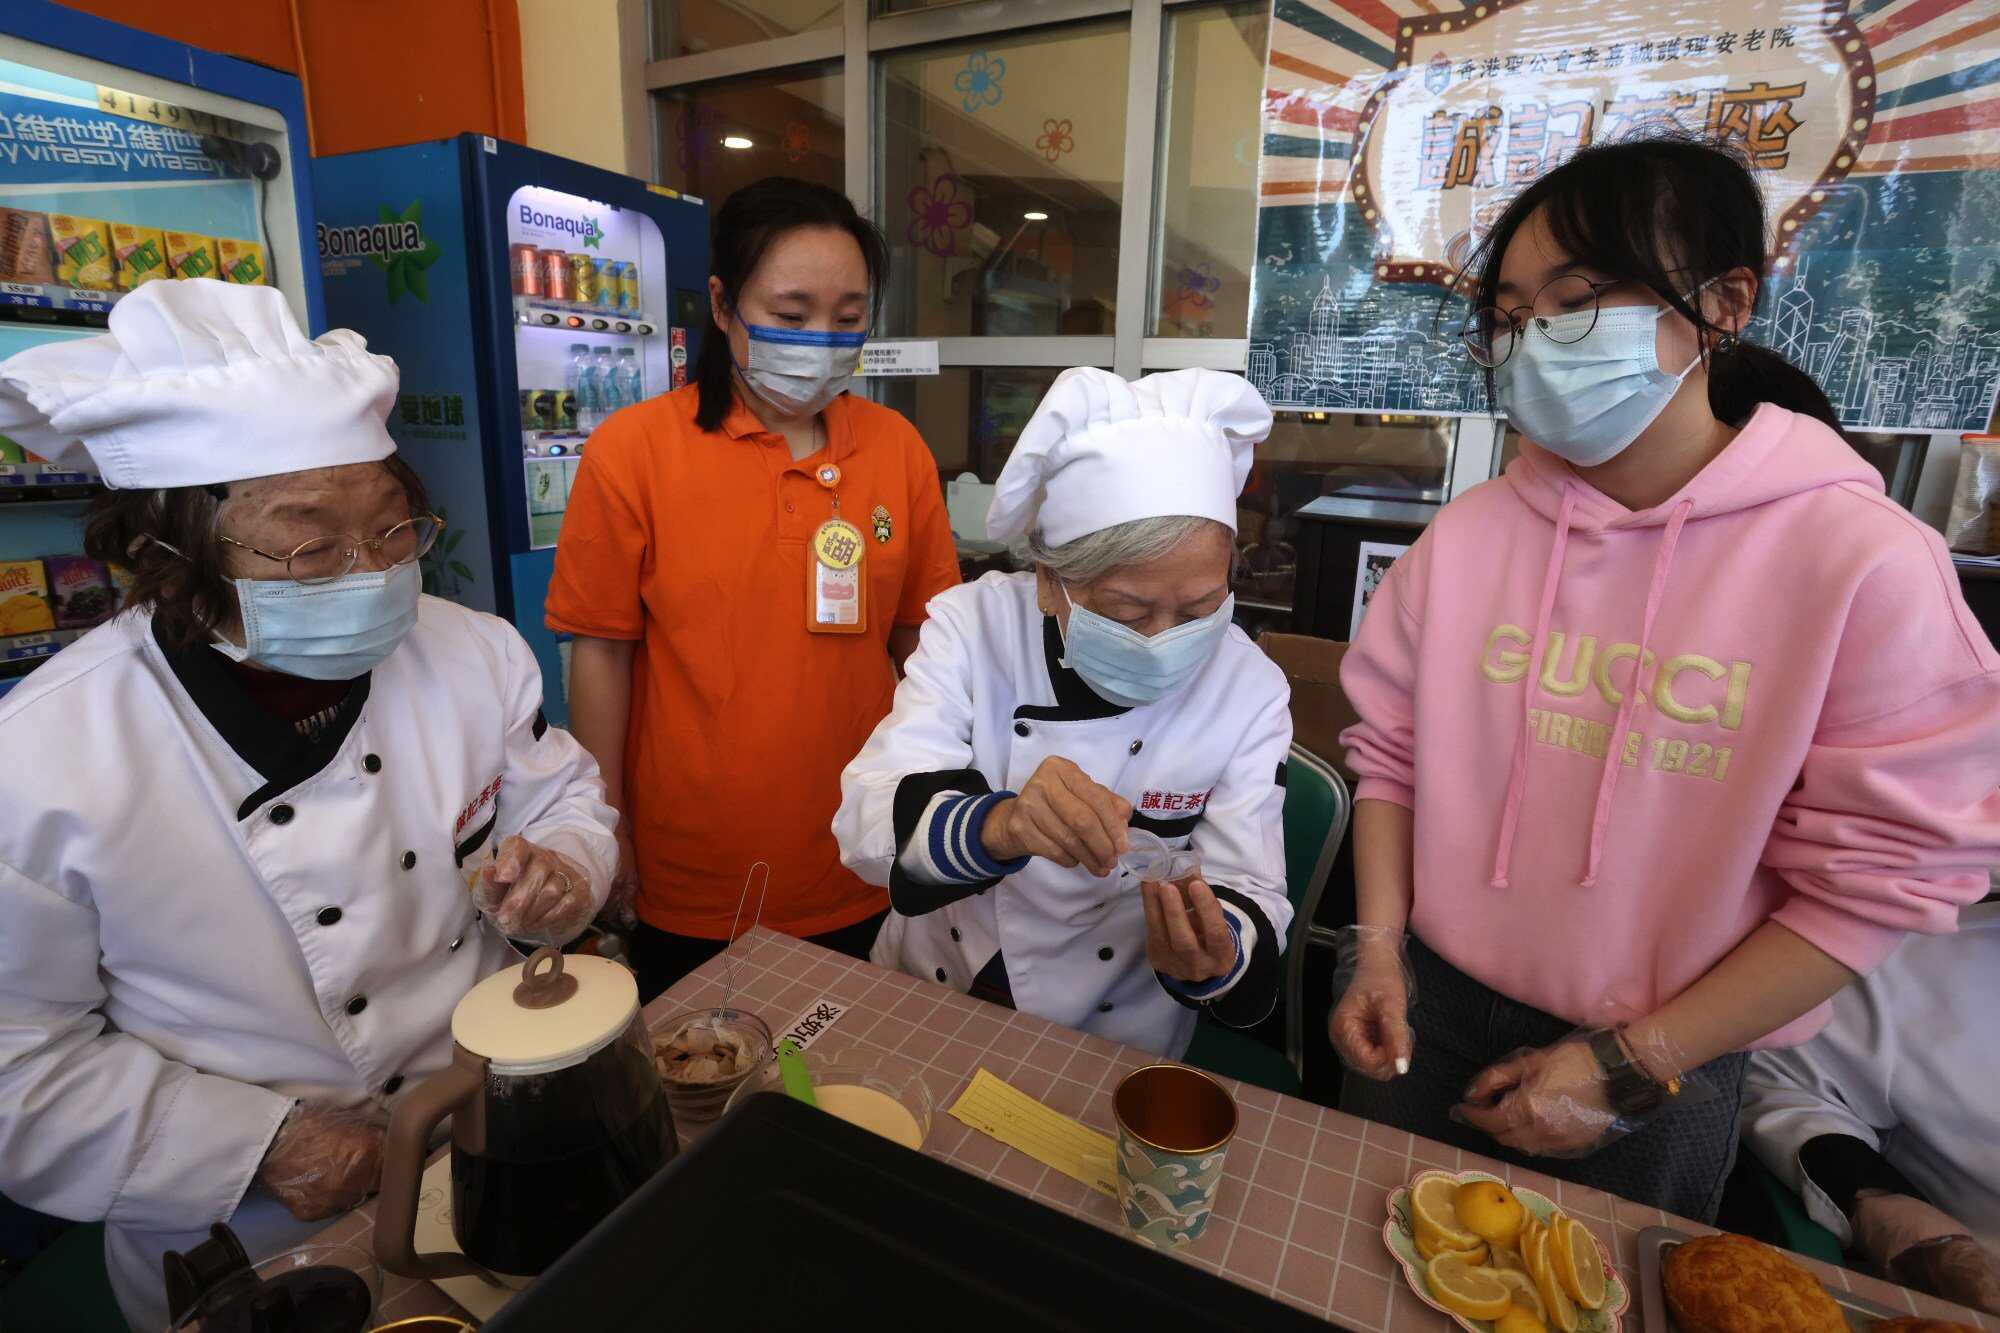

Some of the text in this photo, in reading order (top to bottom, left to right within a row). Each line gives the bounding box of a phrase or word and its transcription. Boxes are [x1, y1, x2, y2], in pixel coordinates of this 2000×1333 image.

[1458, 25, 1797, 80] 香港聖公會李嘉誠護理安老院
[127, 123, 205, 153] 維他
[520, 204, 595, 237] Bonaqua
[317, 222, 420, 261] Bonaqua
[1479, 623, 1751, 731] GUCCI
[1527, 708, 1734, 783] FIRENE 1921
[1141, 788, 1213, 810] 誠記茶
